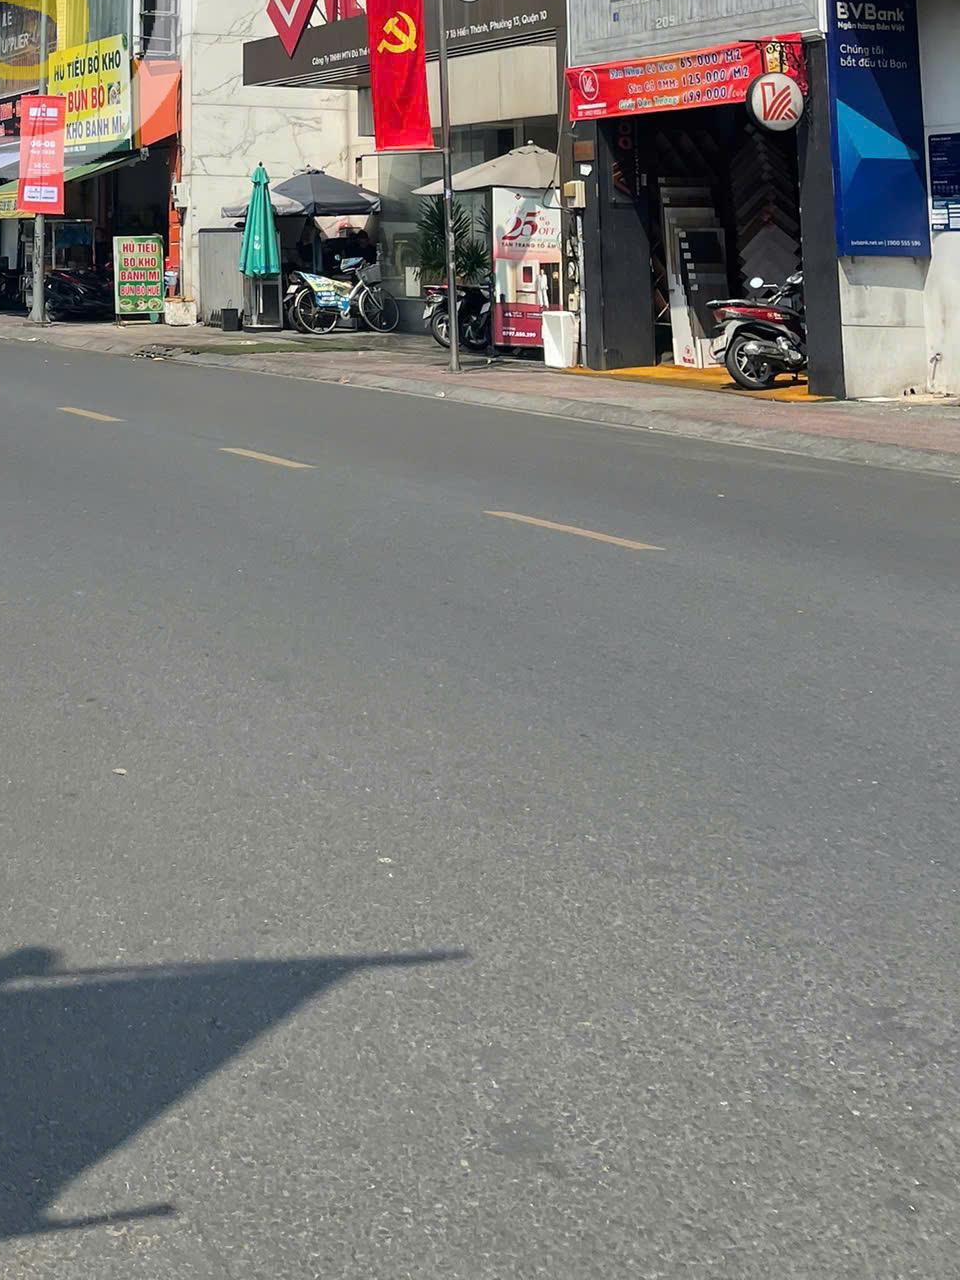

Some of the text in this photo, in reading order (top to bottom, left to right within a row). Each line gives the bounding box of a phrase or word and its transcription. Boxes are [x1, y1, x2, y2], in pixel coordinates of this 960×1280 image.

[521, 13, 539, 25] Quận
[540, 10, 548, 20] 10
[836, 1, 904, 22] BVBank
[838, 21, 857, 30] Ngân
[858, 22, 875, 31] hàng
[891, 23, 905, 32] Việt
[840, 44, 884, 57] Chúng tôi
[88, 50, 99, 75] BÒ
[102, 49, 121, 71] KHO
[840, 55, 908, 70] bắt đầu từ Bạn
[68, 79, 105, 112] BÚN BÒ
[66, 121, 83, 140] KHO
[138, 257, 157, 267] KHO
